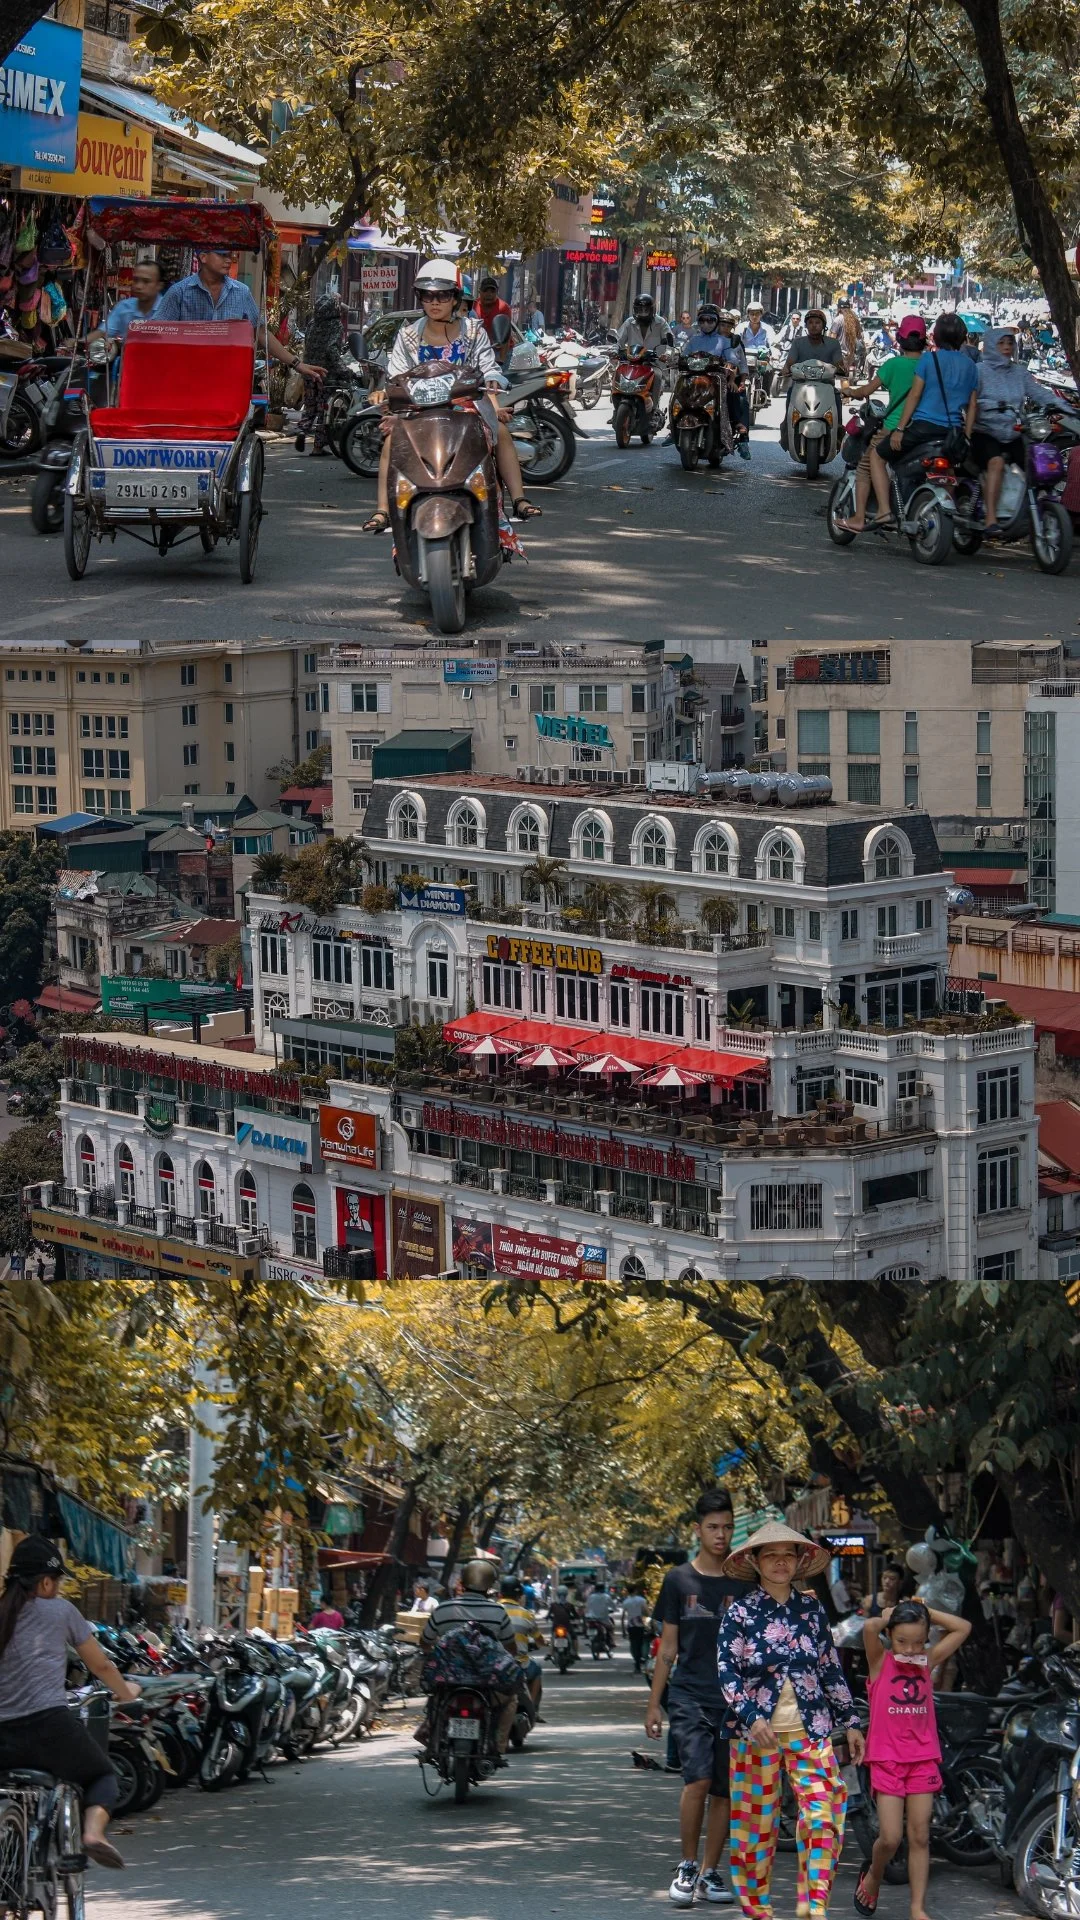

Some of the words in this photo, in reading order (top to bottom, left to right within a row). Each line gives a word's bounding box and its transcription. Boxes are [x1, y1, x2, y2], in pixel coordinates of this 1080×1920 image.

[76, 136, 147, 182] ouvenir
[113, 448, 219, 469] DONTWORRY
[424, 889, 456, 901] MINH
[419, 899, 461, 912] DIAMOND
[555, 943, 604, 975] CLUB
[251, 1129, 308, 1157] DAIKIN
[320, 1136, 357, 1154] Hanwha
[358, 1144, 375, 1157] Life
[32, 1220, 55, 1233] SONY
[541, 1250, 560, 1264] BUFFET
[206, 1259, 232, 1271] GoPro
[267, 1264, 298, 1280] HSBC
[887, 1706, 928, 1715] CHANEL
